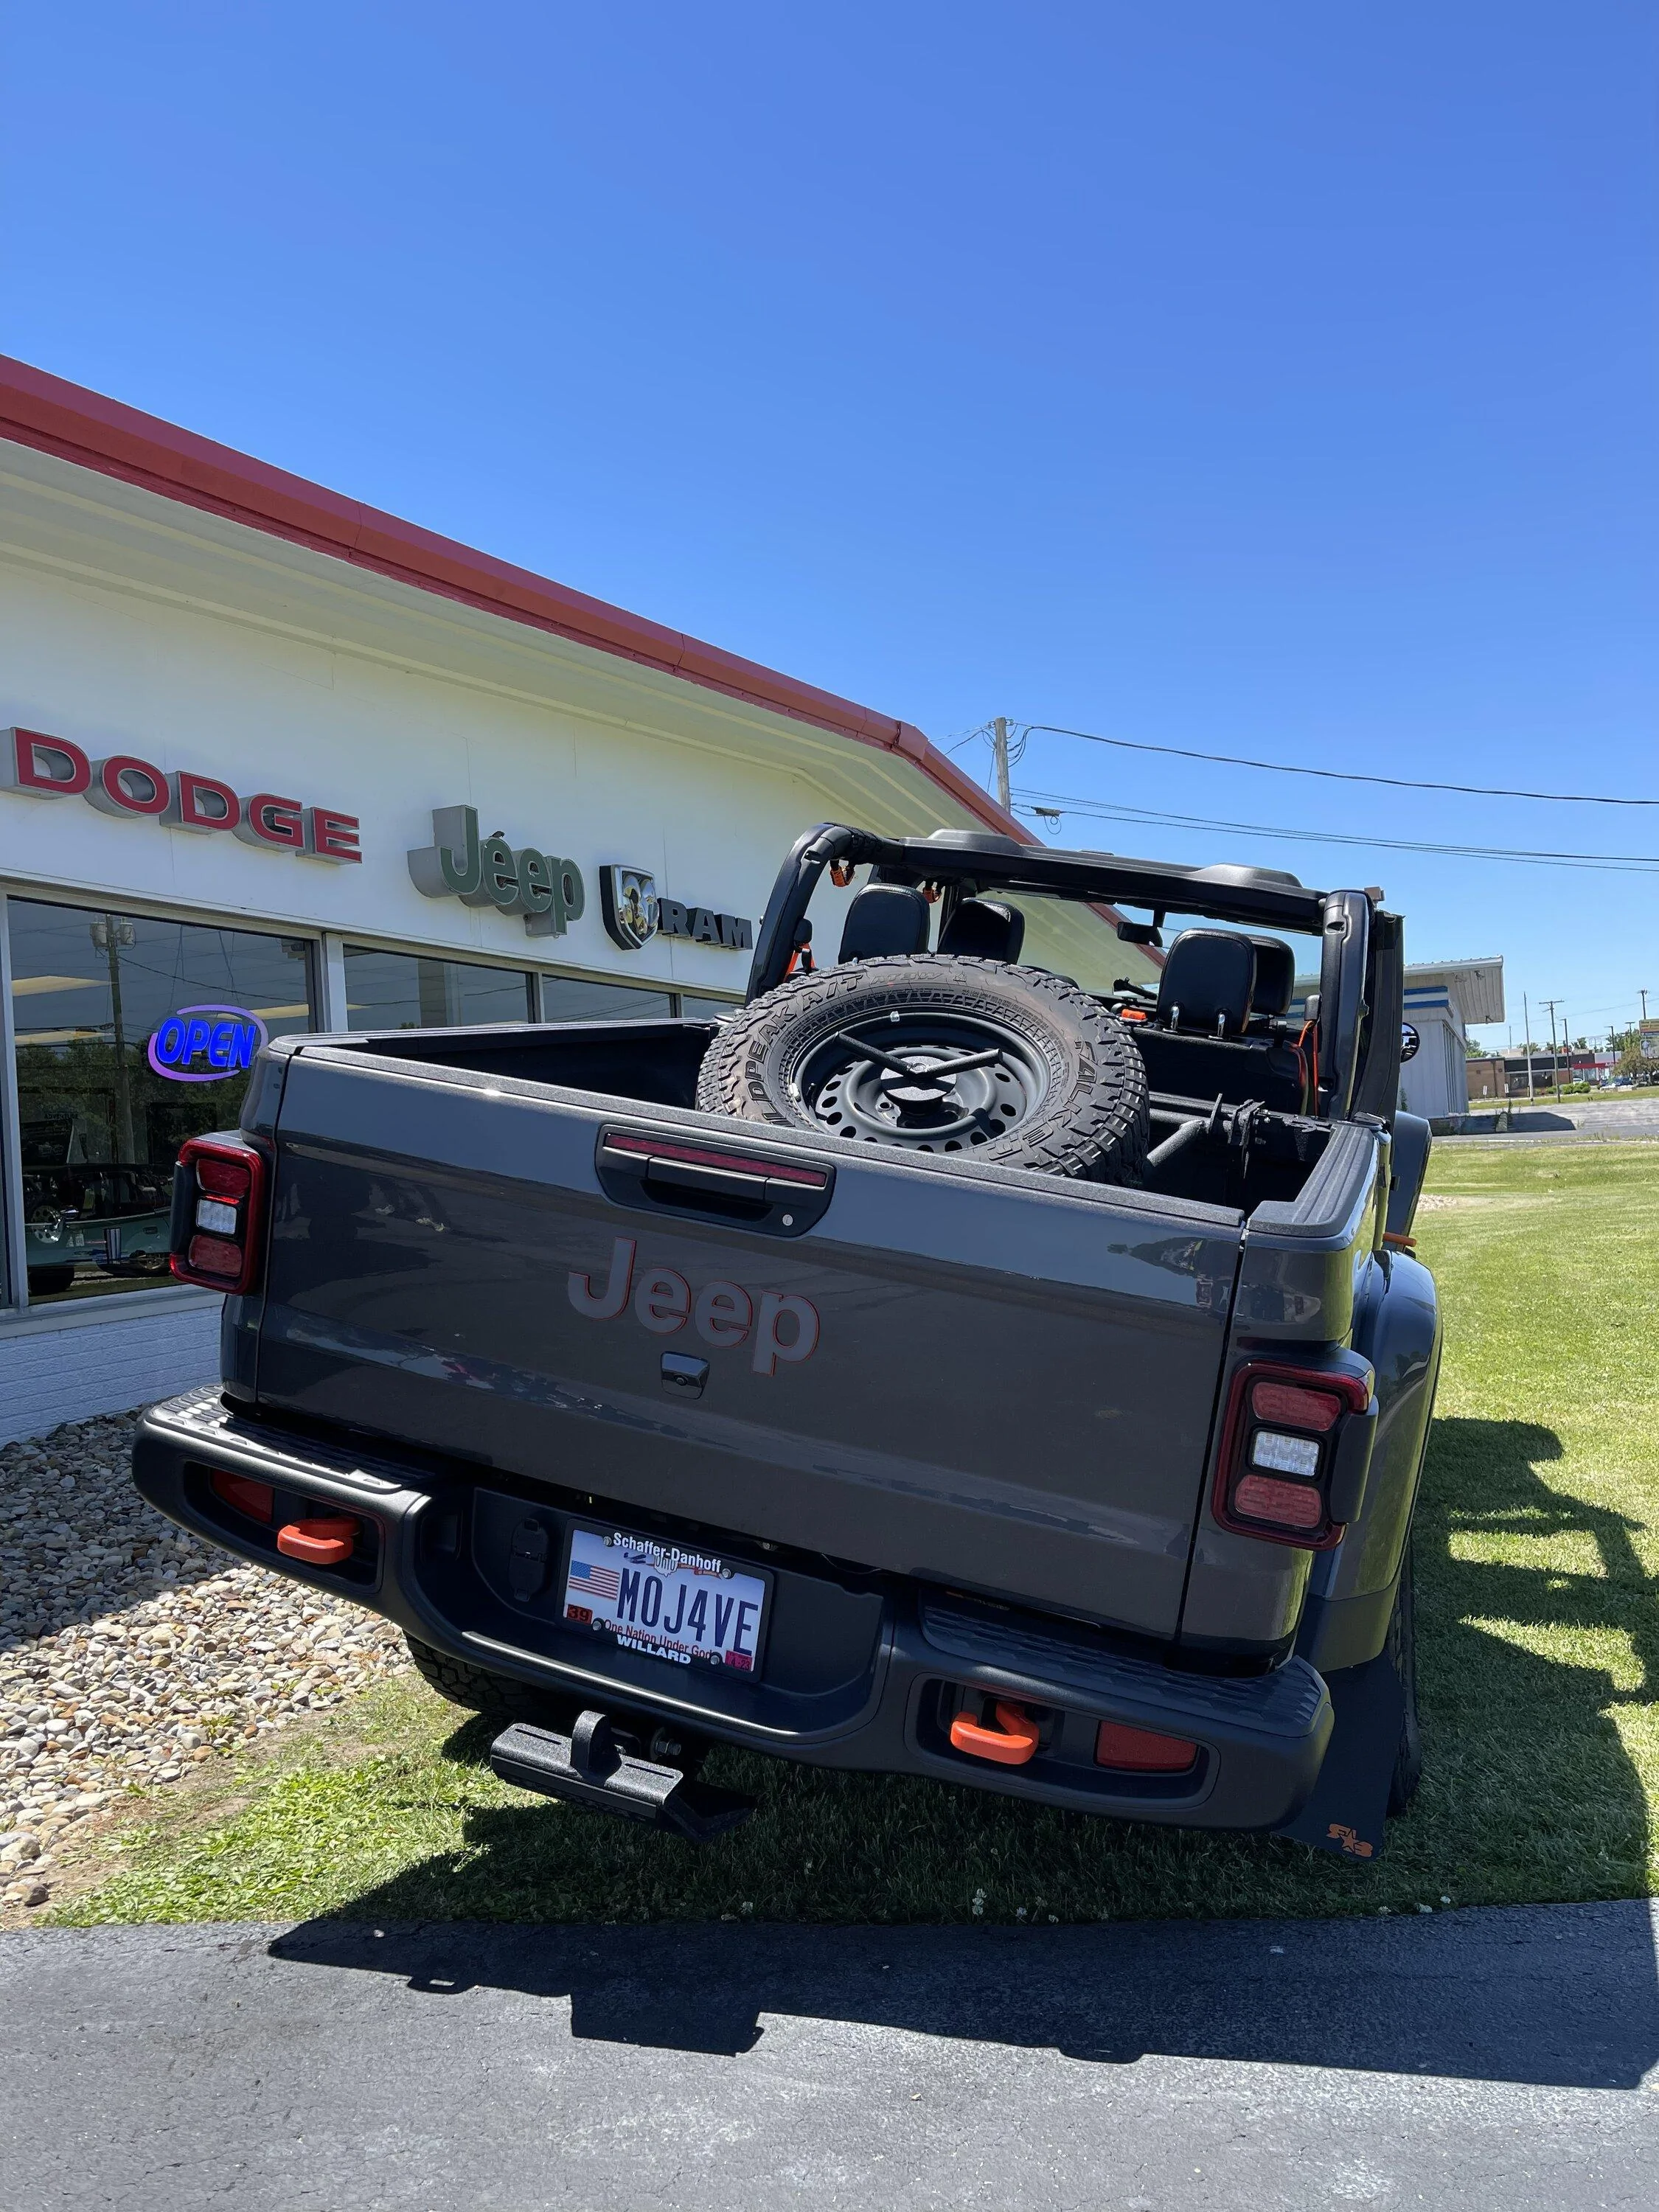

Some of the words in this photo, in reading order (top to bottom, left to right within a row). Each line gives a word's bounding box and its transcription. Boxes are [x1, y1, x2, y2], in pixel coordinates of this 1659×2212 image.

[13, 726, 363, 864] DODGE
[440, 804, 585, 936] Jeep
[658, 897, 753, 950] RAM
[157, 1017, 257, 1068] OPEN
[745, 1006, 796, 1127] ILDPEAK
[568, 1237, 820, 1376] Jeep
[613, 1532, 721, 1573] Schaffer-Danhoff
[568, 1605, 589, 1621] 39
[605, 1619, 623, 1635] One
[626, 1625, 656, 1644] Nation
[660, 1635, 689, 1652] Under
[616, 1568, 759, 1656] MOJ4VE
[616, 1634, 692, 1665] WILLARD
